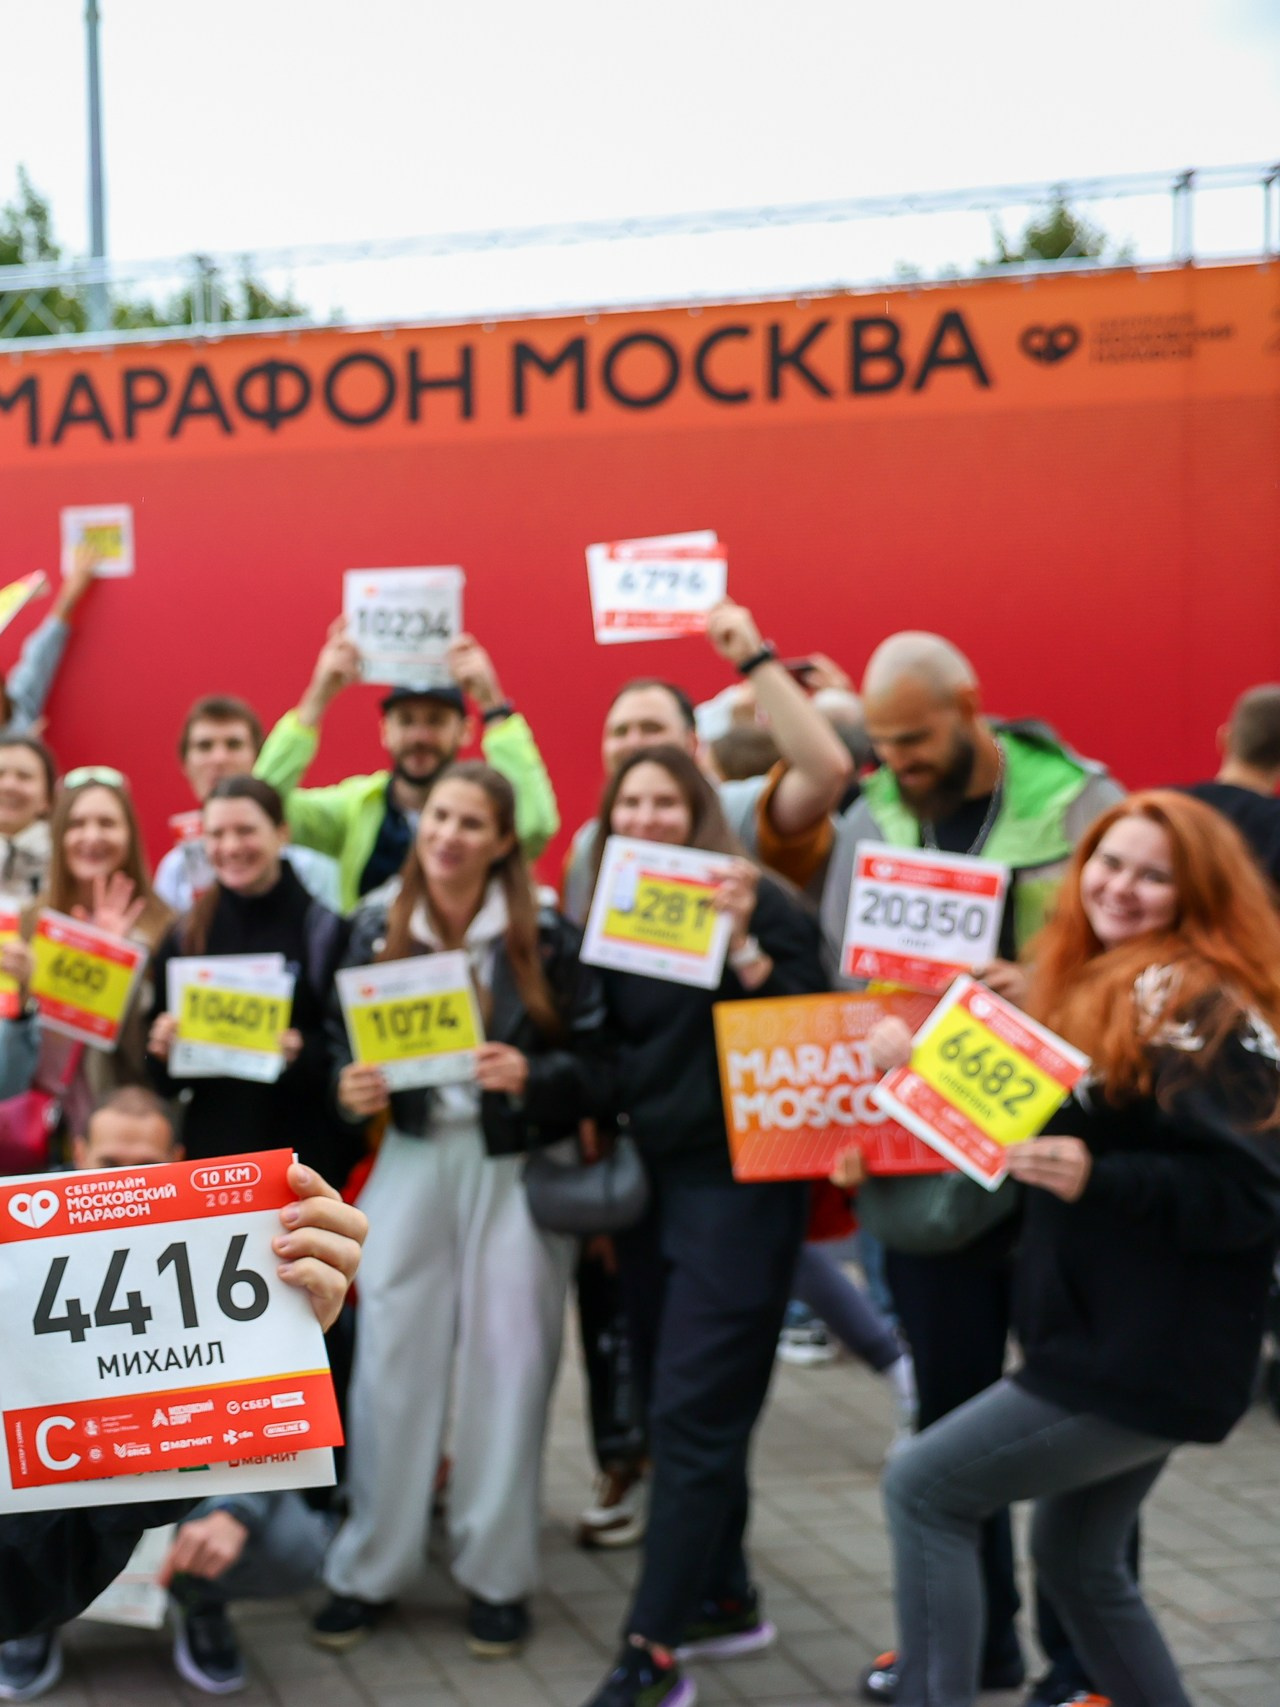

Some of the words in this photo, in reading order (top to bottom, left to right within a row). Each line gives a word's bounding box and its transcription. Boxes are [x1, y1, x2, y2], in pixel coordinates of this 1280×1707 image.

[510, 308, 994, 418] МОСКВА
[357, 606, 451, 640] 10234
[619, 886, 711, 931] 281
[859, 888, 987, 941] 20350
[50, 953, 108, 995] 600
[187, 991, 280, 1032] 10401
[368, 996, 460, 1042] 1074
[727, 1005, 840, 1048] 2026
[727, 1040, 875, 1089] MARAT
[938, 1028, 1039, 1118] 6682
[732, 1082, 888, 1132] MOSCO
[65, 1176, 146, 1196] СБЕРПРАЙМ
[66, 1183, 177, 1210] МОСКОВСКИЙ
[200, 1171, 219, 1186] 10
[205, 1189, 254, 1208] 2026
[68, 1203, 151, 1225] МАРАФОН
[32, 1233, 270, 1344] 4416
[96, 1341, 225, 1380] МИХАИЛ
[241, 1398, 271, 1411] СБЕР
